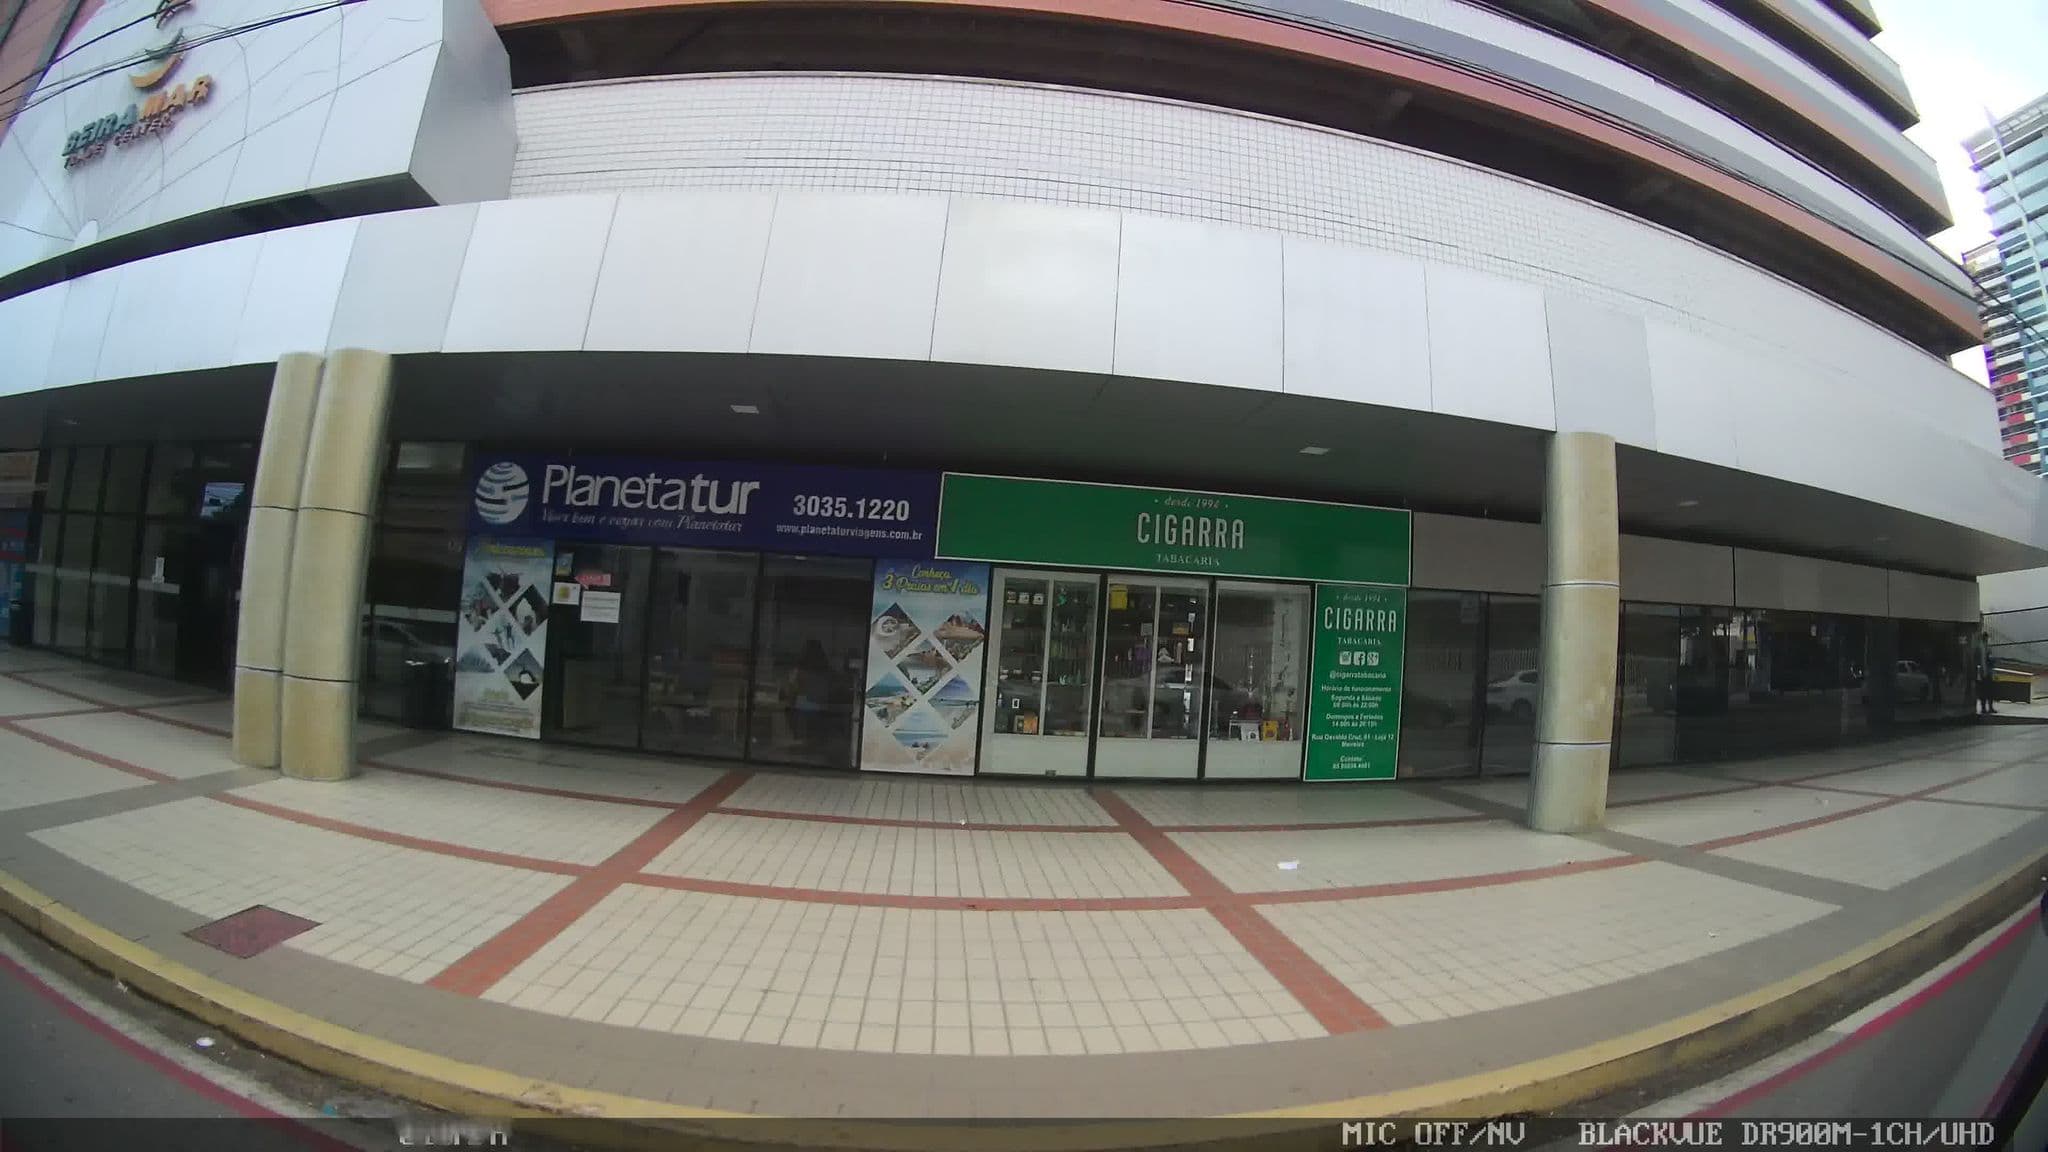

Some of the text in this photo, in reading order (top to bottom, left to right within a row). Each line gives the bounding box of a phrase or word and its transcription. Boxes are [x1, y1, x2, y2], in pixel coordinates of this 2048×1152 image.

[542, 464, 761, 515] Planetatur
[792, 494, 910, 521] 3035.1220
[1137, 512, 1244, 549] CIGARRA
[1156, 553, 1220, 567] TABACARIA
[1324, 606, 1397, 633] CIGARRA
